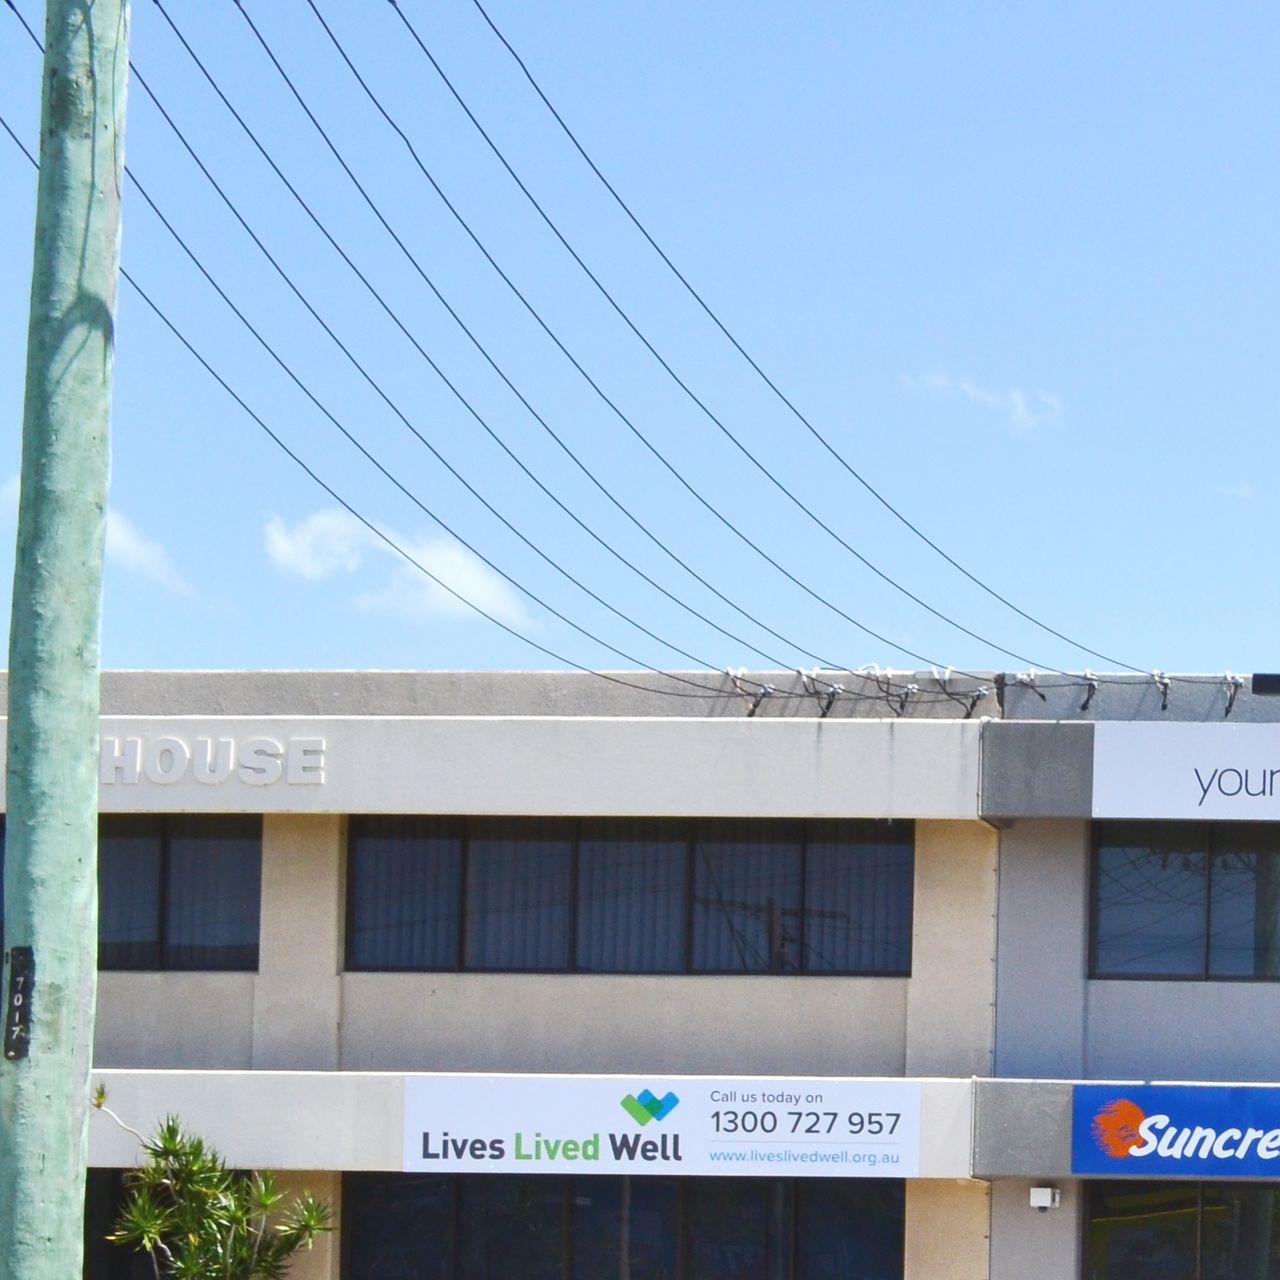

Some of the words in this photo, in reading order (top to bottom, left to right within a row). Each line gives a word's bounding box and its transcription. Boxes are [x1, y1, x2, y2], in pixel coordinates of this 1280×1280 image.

[99, 736, 325, 786] HOUSE
[710, 1090, 737, 1102] Call
[742, 1092, 757, 1103] us
[762, 1091, 801, 1106] today
[805, 1093, 823, 1104] on
[711, 1111, 777, 1133] 1300
[787, 1112, 838, 1134] 727
[848, 1112, 901, 1135] 957
[422, 1131, 505, 1160] Lives
[514, 1132, 599, 1161] Lived
[609, 1133, 682, 1161] Well
[710, 1149, 899, 1166] www.liveslivedwell.org.au
